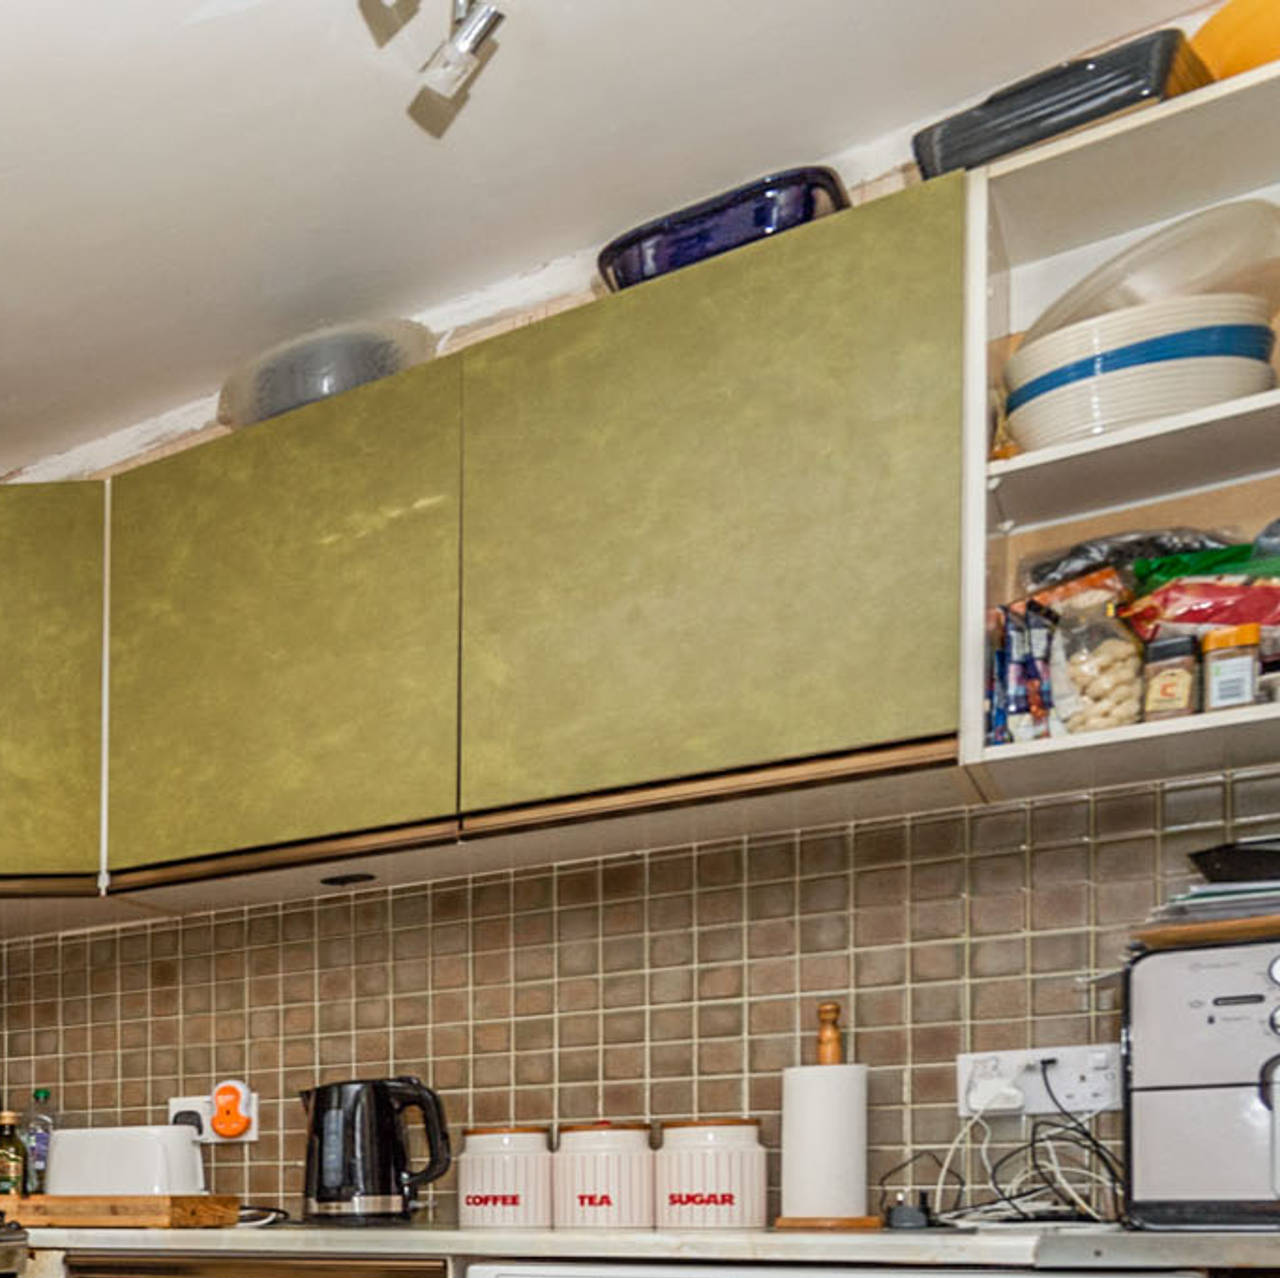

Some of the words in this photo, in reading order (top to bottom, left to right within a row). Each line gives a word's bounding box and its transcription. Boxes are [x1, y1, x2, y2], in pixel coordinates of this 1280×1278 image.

[465, 1194, 520, 1207] COFFEE
[577, 1193, 613, 1207] TEA
[668, 1192, 735, 1206] SUGAR
